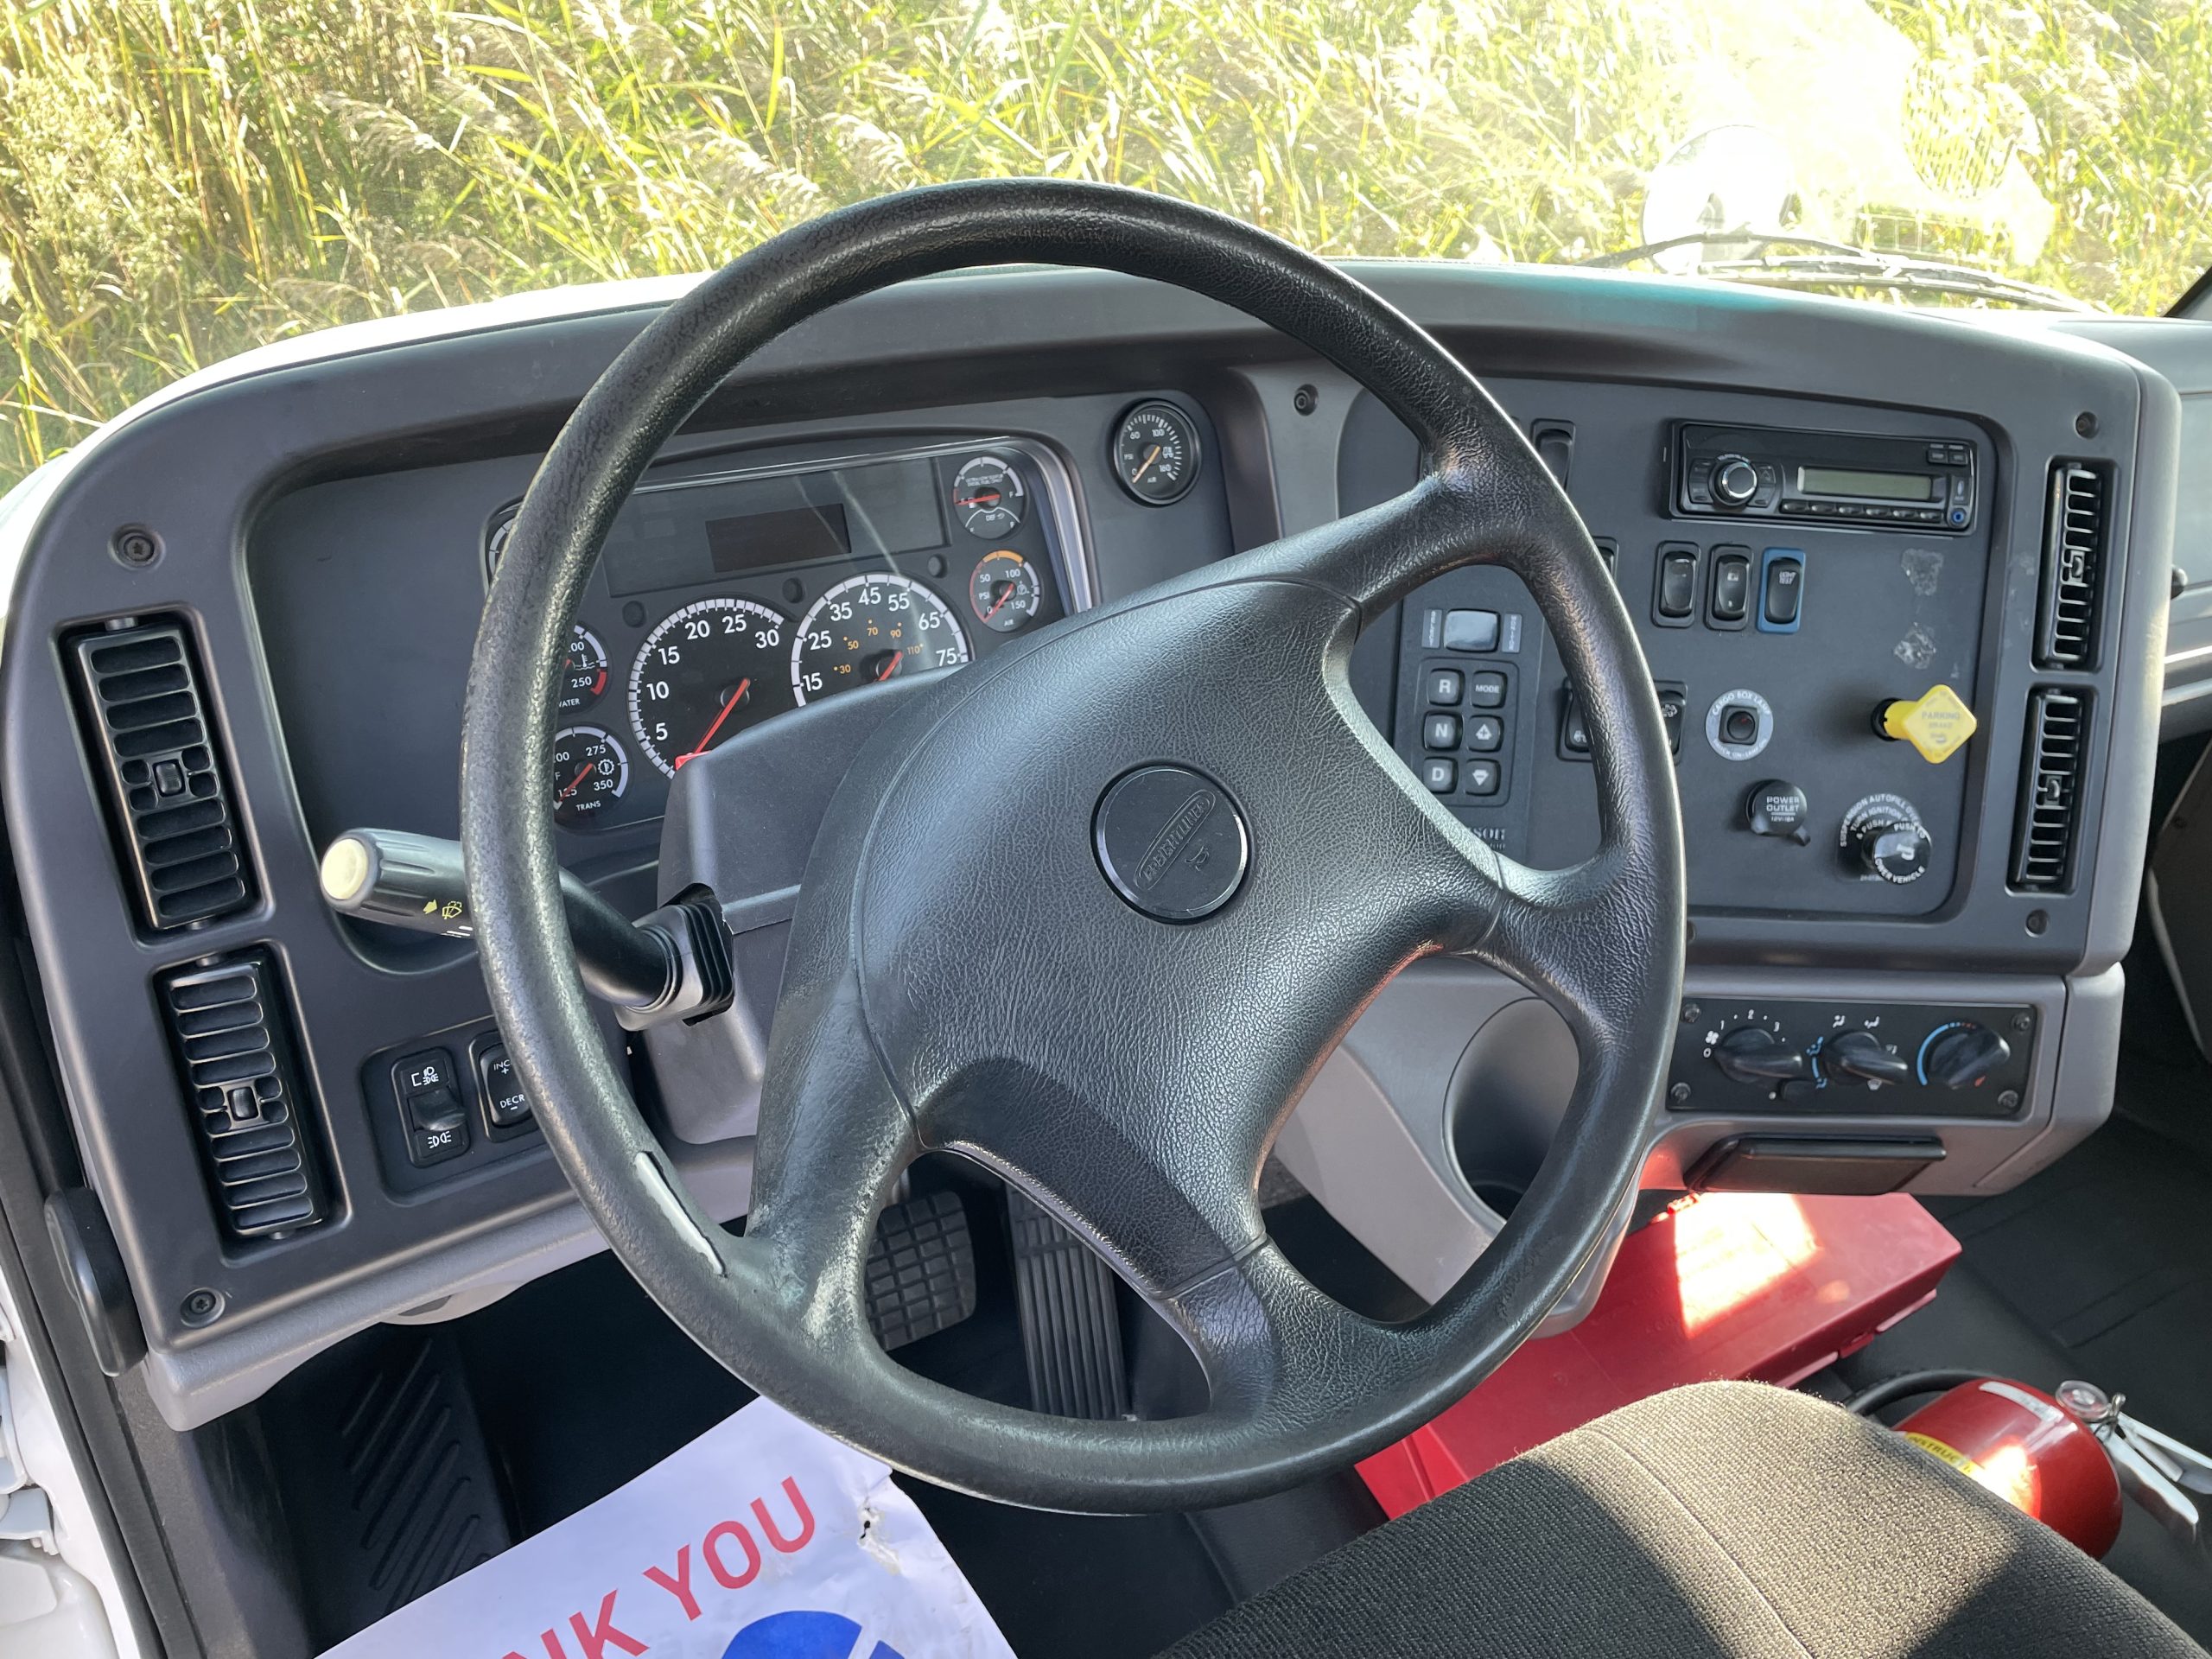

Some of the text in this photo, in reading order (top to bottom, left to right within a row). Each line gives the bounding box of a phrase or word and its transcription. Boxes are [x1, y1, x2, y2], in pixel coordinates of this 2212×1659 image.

[979, 574, 991, 582] 50
[1005, 569, 1020, 578] 100
[858, 587, 881, 605] 45
[888, 593, 910, 611] 55
[830, 602, 852, 621] 35
[1011, 601, 1026, 610] 150
[722, 614, 747, 633] 25
[918, 612, 940, 630] 65
[684, 620, 710, 639] 20
[867, 626, 878, 636] 70
[890, 629, 901, 638] 90
[755, 629, 779, 649] 30
[808, 631, 832, 650] 25
[848, 640, 859, 650] 50
[568, 641, 585, 652] 00
[907, 646, 920, 655] 110
[658, 646, 680, 665] 15
[936, 648, 957, 666] 75
[840, 664, 851, 674] 30
[571, 677, 592, 689] 250
[803, 672, 823, 691] 15
[1439, 679, 1451, 693] R
[646, 681, 670, 700] 10
[1475, 684, 1500, 693] MODE
[656, 722, 668, 741] 5
[1435, 724, 1448, 737] N
[586, 746, 607, 756] 275
[555, 752, 570, 763] 00
[1432, 767, 1445, 780] D
[594, 779, 613, 791] 350
[576, 801, 601, 811] TRANS
[1766, 804, 1799, 812] OUTLET
[1748, 1009, 1754, 1020] 2
[493, 1059, 511, 1071] INC
[499, 1094, 525, 1109] DECR
[642, 1476, 816, 1621] YOU
